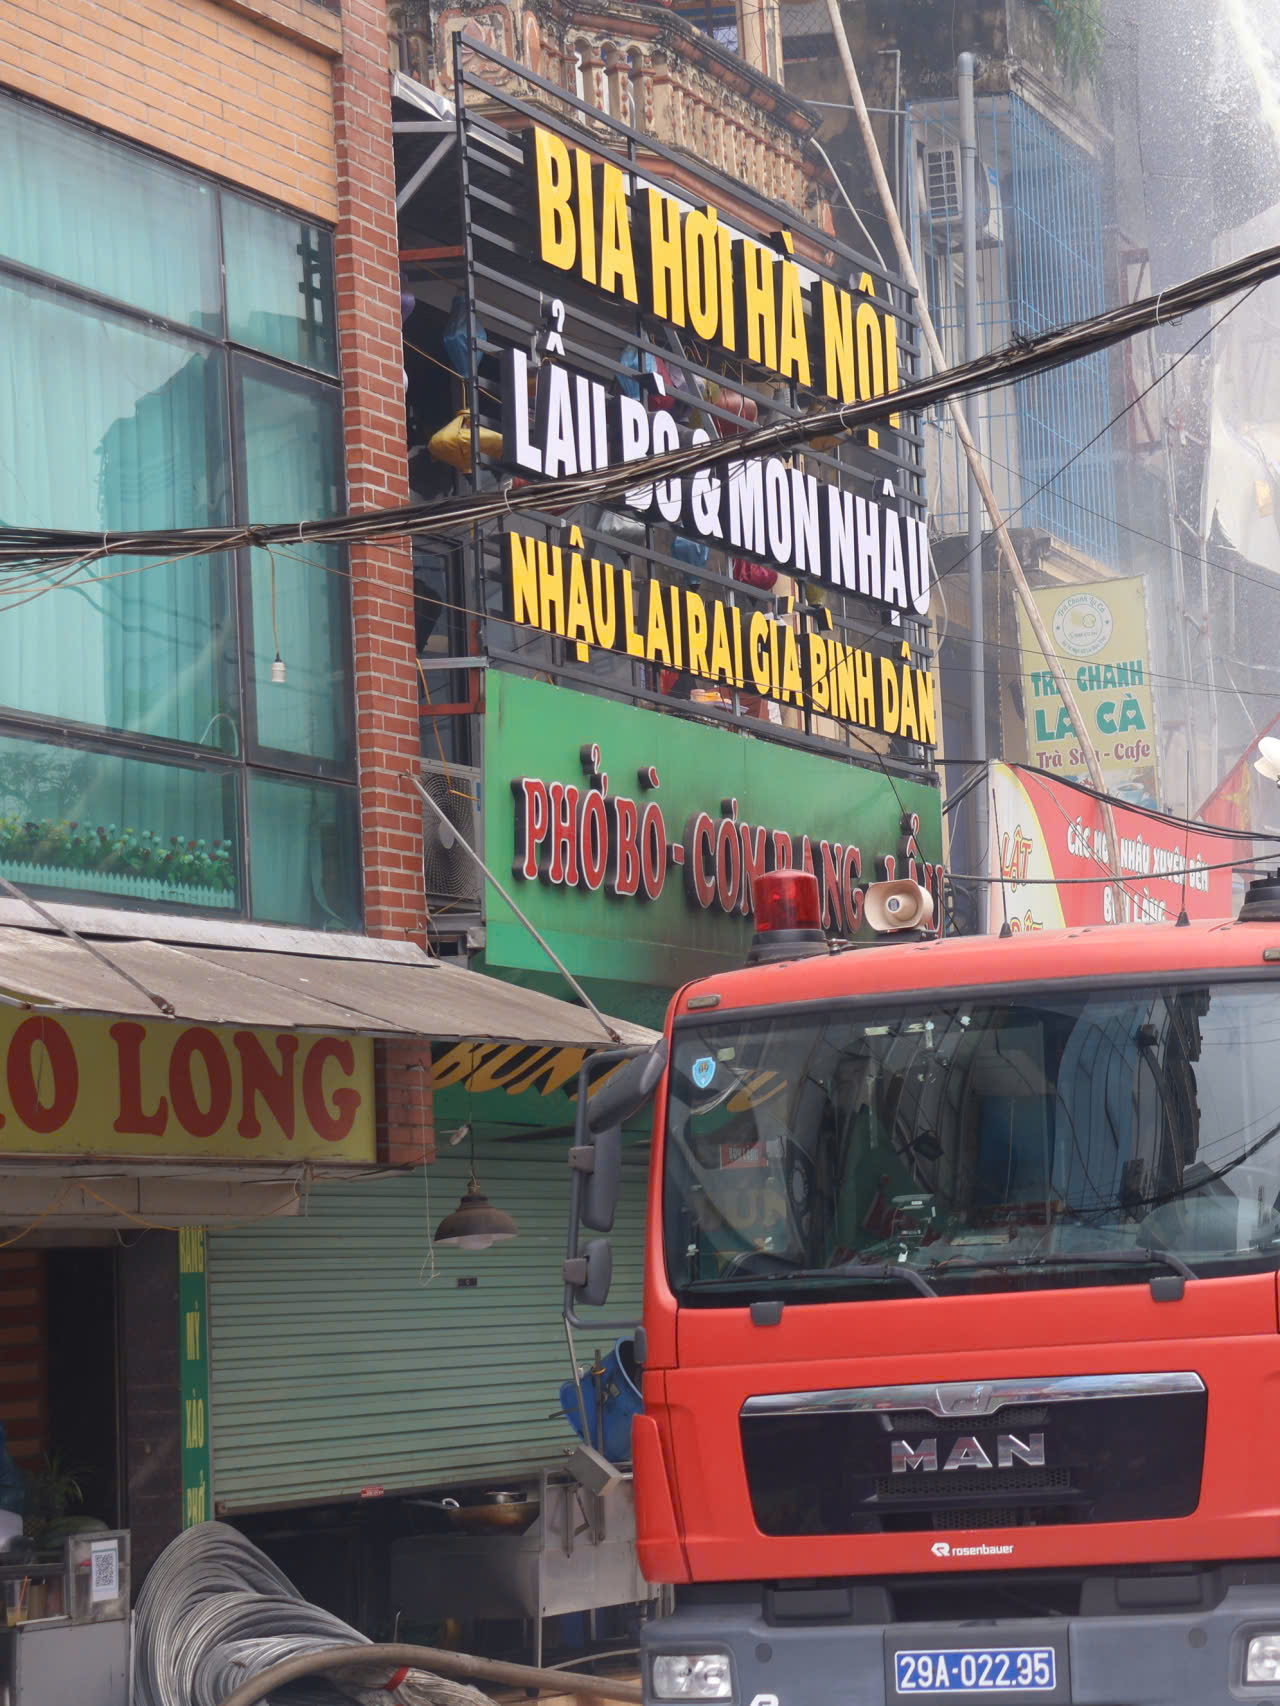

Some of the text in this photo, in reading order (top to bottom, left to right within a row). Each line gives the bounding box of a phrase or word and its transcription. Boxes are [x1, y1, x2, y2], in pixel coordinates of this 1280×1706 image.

[534, 125, 901, 450] BIA HƠI HÀ NỘI
[691, 428, 724, 539] &
[828, 478, 931, 627] NHẬU
[509, 524, 937, 745] NHẬU LAI RAI GIÁ BÌNH DÂN
[1030, 659, 1145, 698] TR CHANH
[1096, 692, 1147, 735] CÀ
[1036, 749, 1063, 769] Trà
[1114, 739, 1151, 764] Cafe
[523, 743, 609, 891] PHỞ
[614, 765, 667, 901] BÒ
[0, 1015, 362, 1142] O LONG
[890, 1432, 1047, 1474] MAN
[952, 1543, 1015, 1557] rosenbauer
[899, 1650, 1051, 1691] 29A-022.95
